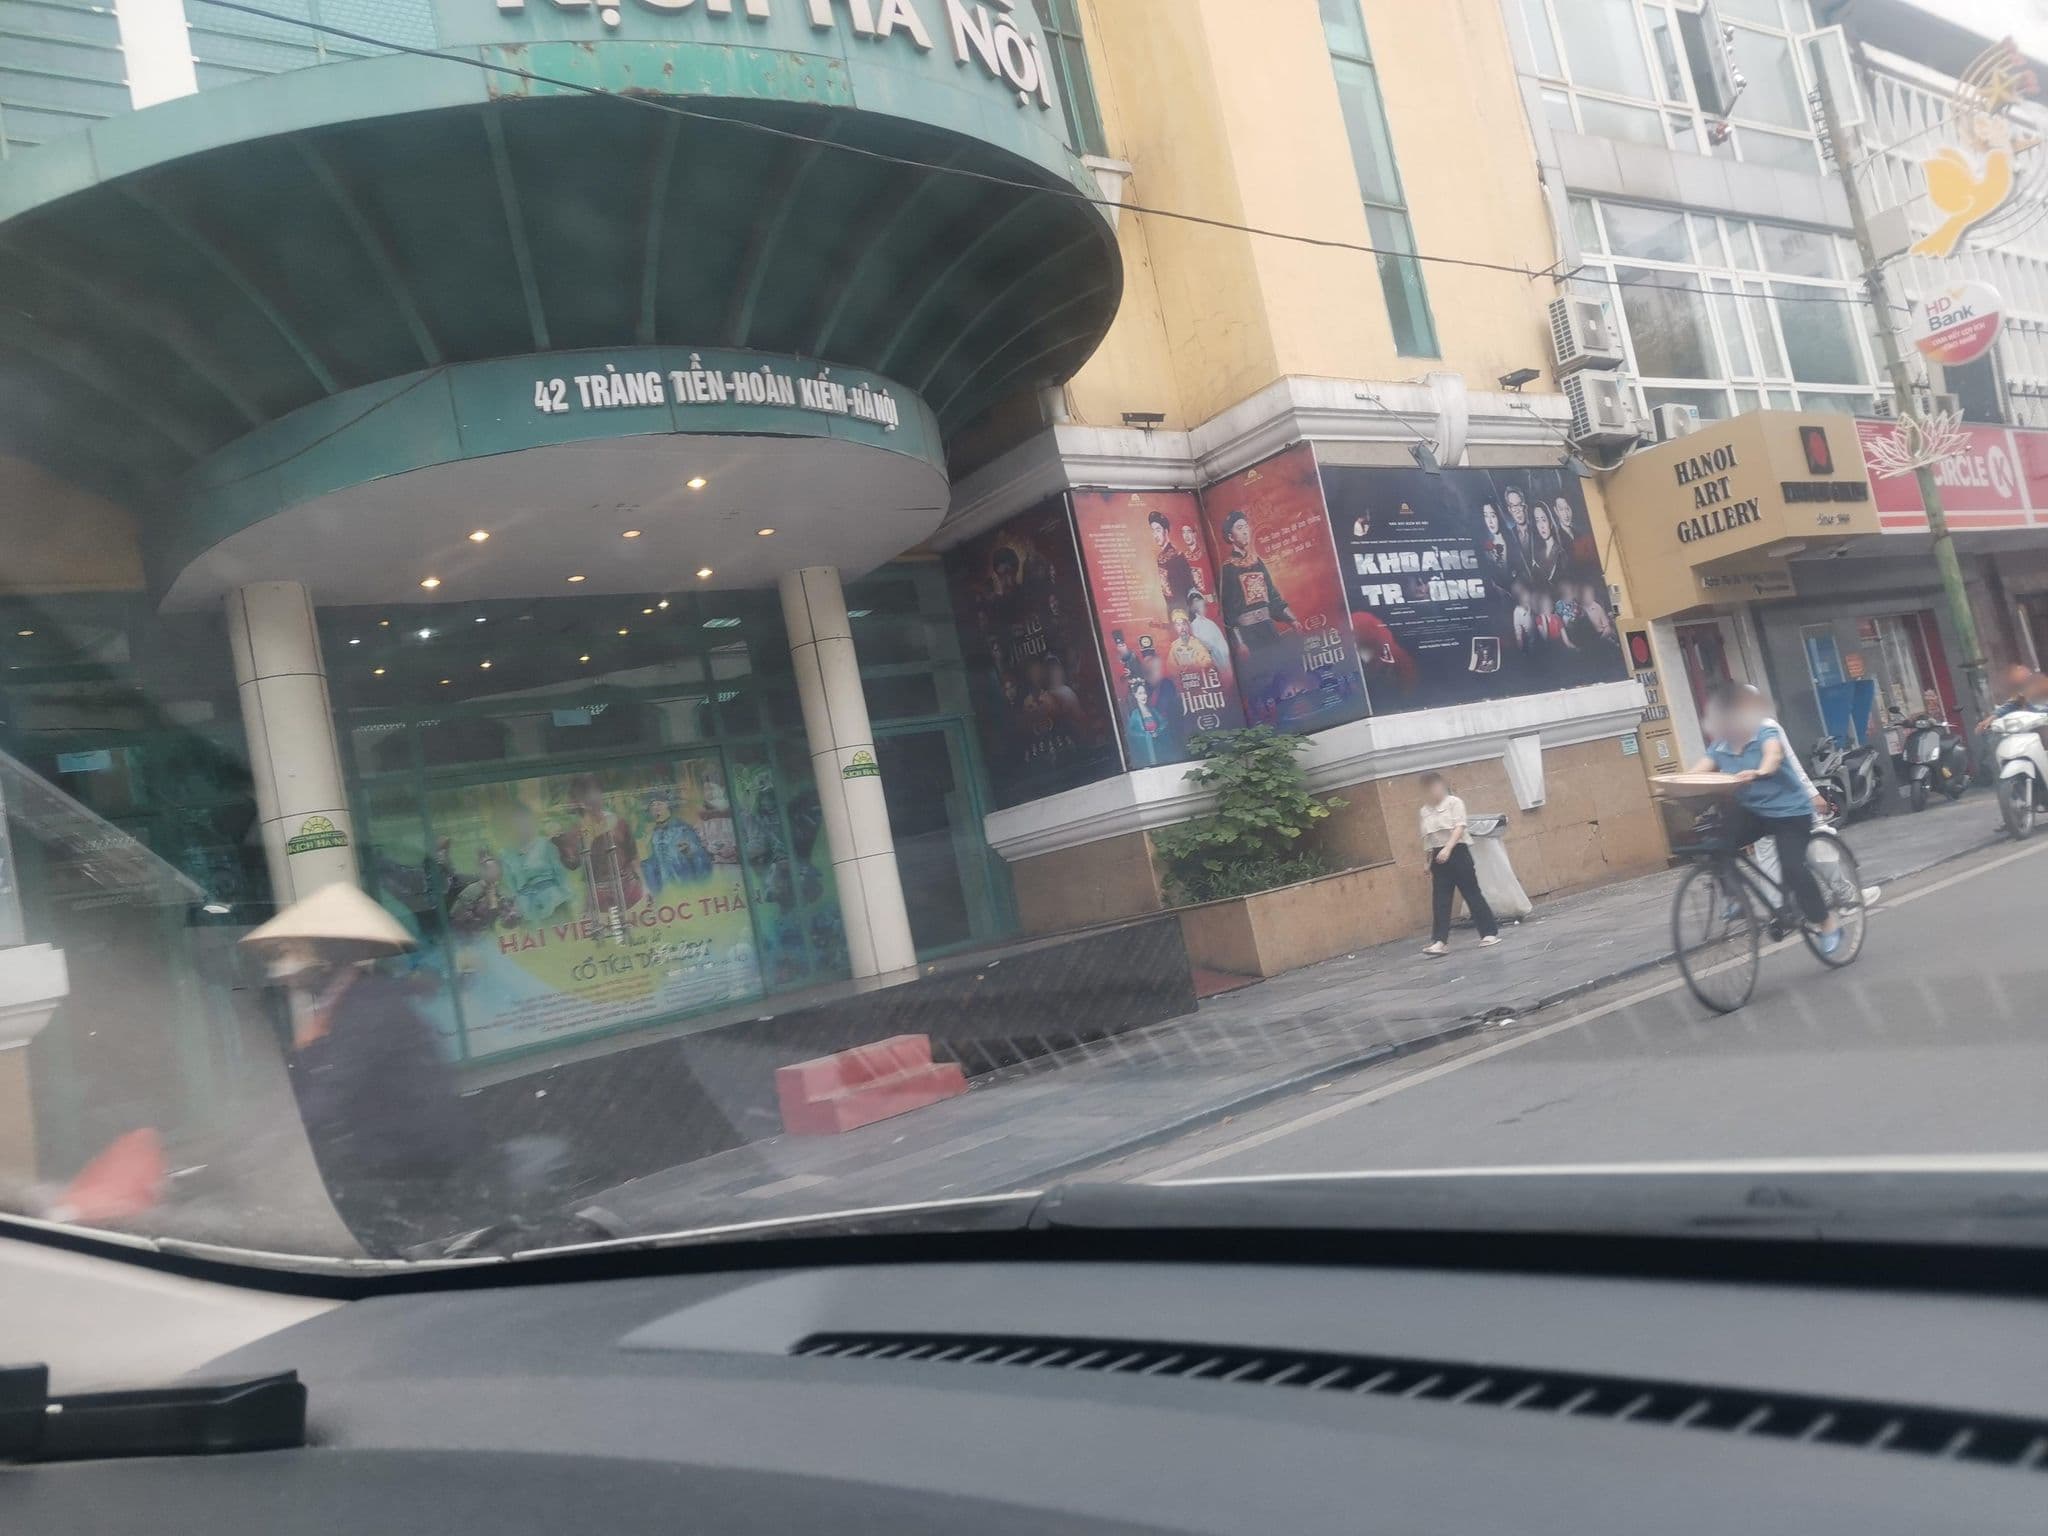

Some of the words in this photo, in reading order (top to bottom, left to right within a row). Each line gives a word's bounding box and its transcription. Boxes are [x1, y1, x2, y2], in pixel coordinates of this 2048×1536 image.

[1926, 297, 1952, 317] HD
[1928, 304, 1975, 331] Bank
[534, 378, 569, 413] 42
[574, 363, 665, 409] TRÀNG
[1674, 444, 1738, 486] HANOI
[1693, 476, 1732, 509] ART
[1677, 497, 1762, 543] GALLERY
[500, 929, 545, 954] HAI
